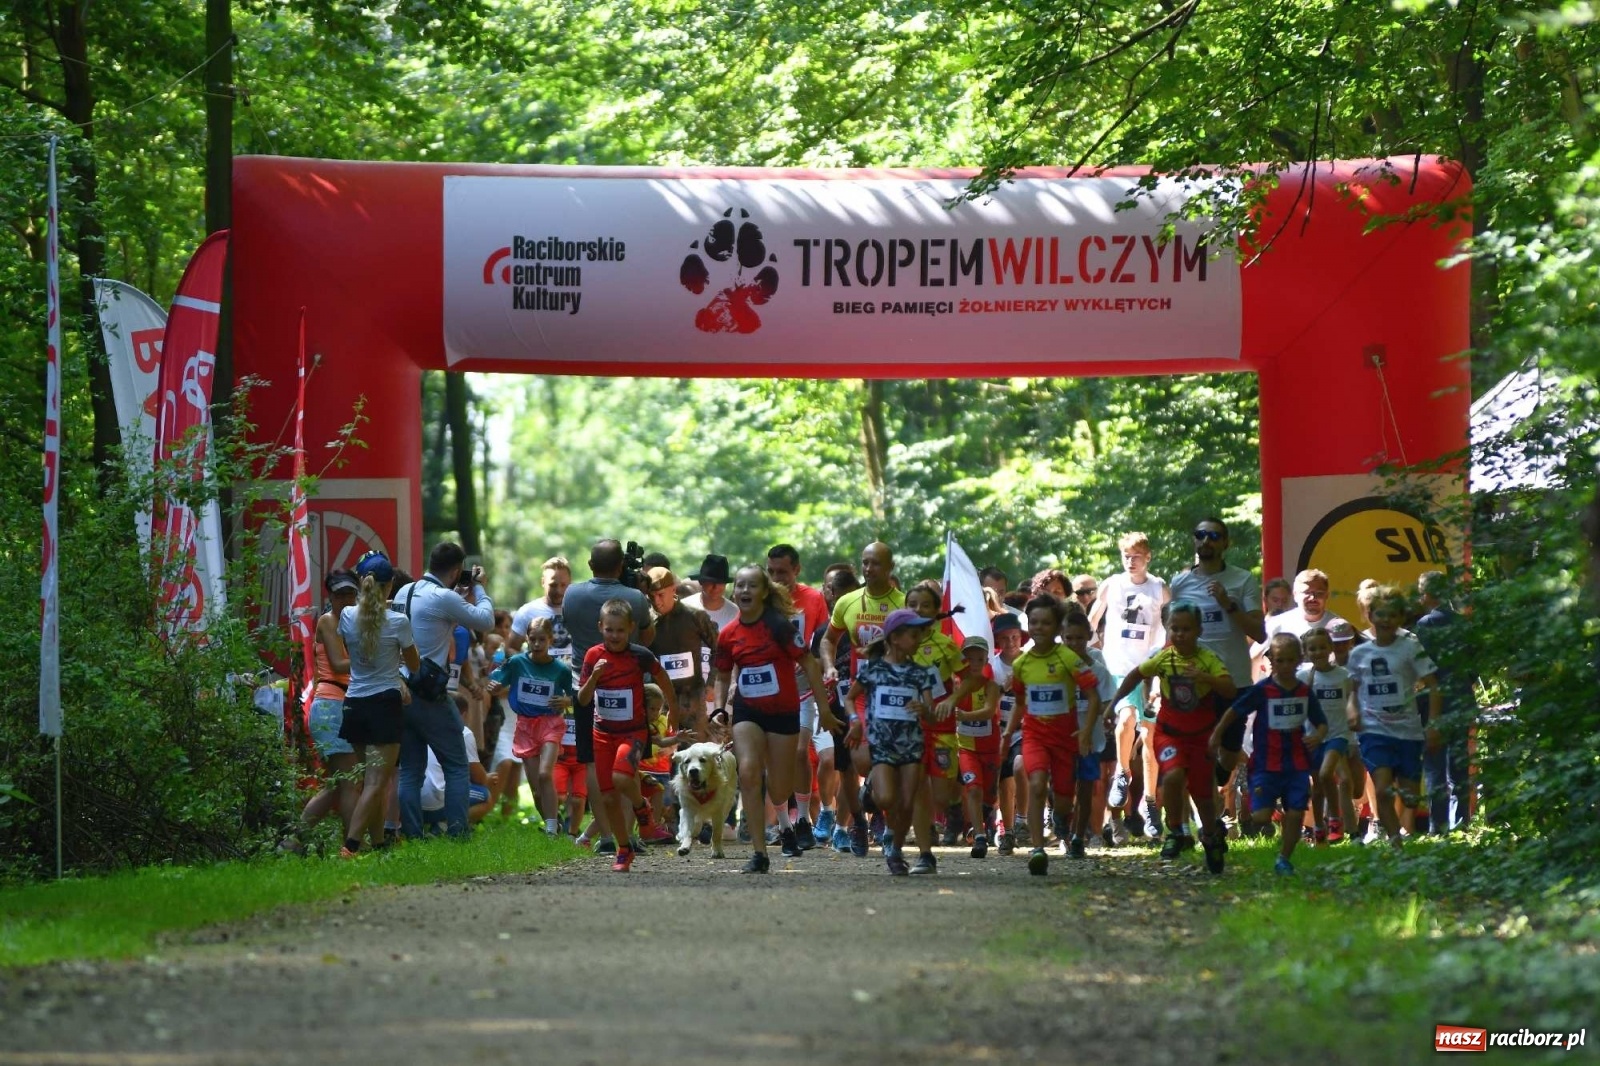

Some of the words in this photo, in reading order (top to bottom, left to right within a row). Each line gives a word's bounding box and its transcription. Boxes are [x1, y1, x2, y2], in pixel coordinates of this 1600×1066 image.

[513, 236, 626, 261] Raciborskie
[513, 286, 582, 315] Kultury
[833, 301, 876, 314] BIEG
[881, 301, 954, 316] PAMIĘCI
[958, 298, 1059, 314] ŻOŁNIERZY
[1064, 298, 1172, 313] WYKLĘTYCH
[670, 660, 684, 669] 12
[748, 674, 763, 684] 83
[529, 684, 543, 694] 75
[1374, 685, 1389, 694] 16
[1038, 690, 1054, 701] 87
[1323, 690, 1337, 699] 60
[604, 698, 619, 708] 82
[888, 695, 905, 706] 96
